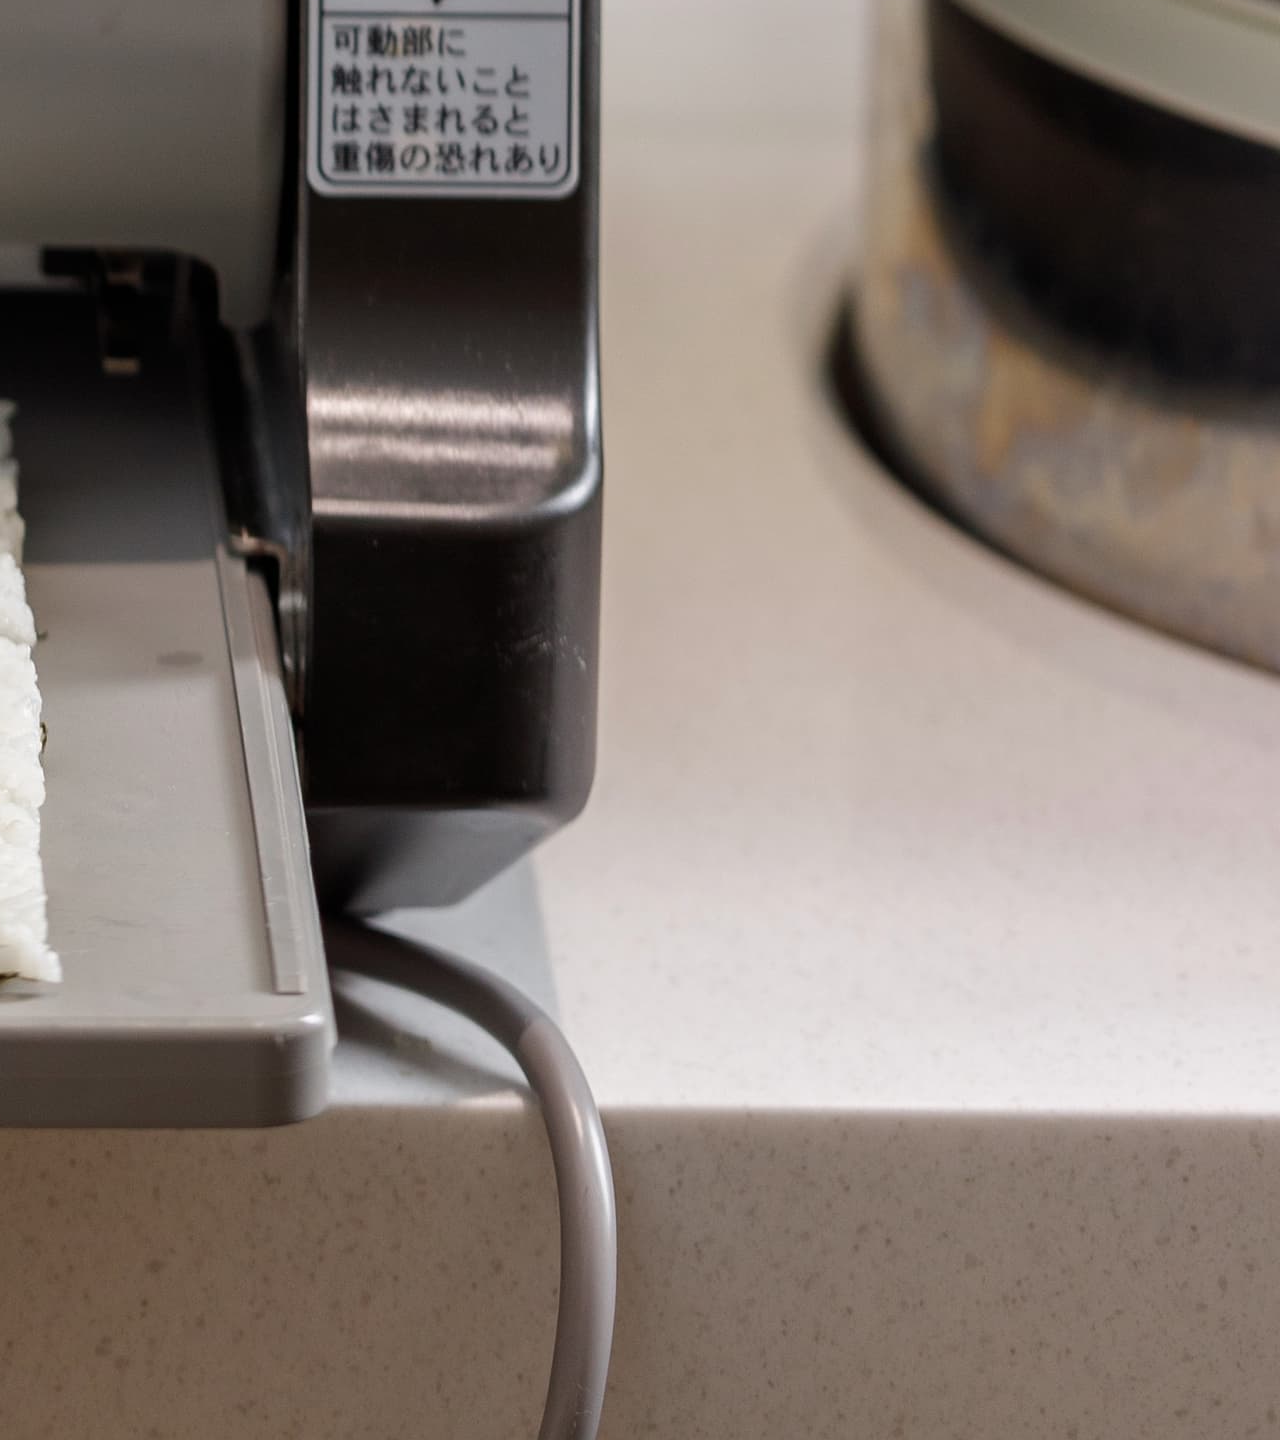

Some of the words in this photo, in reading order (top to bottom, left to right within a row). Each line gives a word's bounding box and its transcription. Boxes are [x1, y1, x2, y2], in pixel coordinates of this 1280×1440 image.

[332, 24, 467, 59] 可動部に
[331, 64, 530, 99] 触れないこと
[332, 103, 530, 137] はさまれると
[331, 141, 561, 175] 重傷の恐れあり
